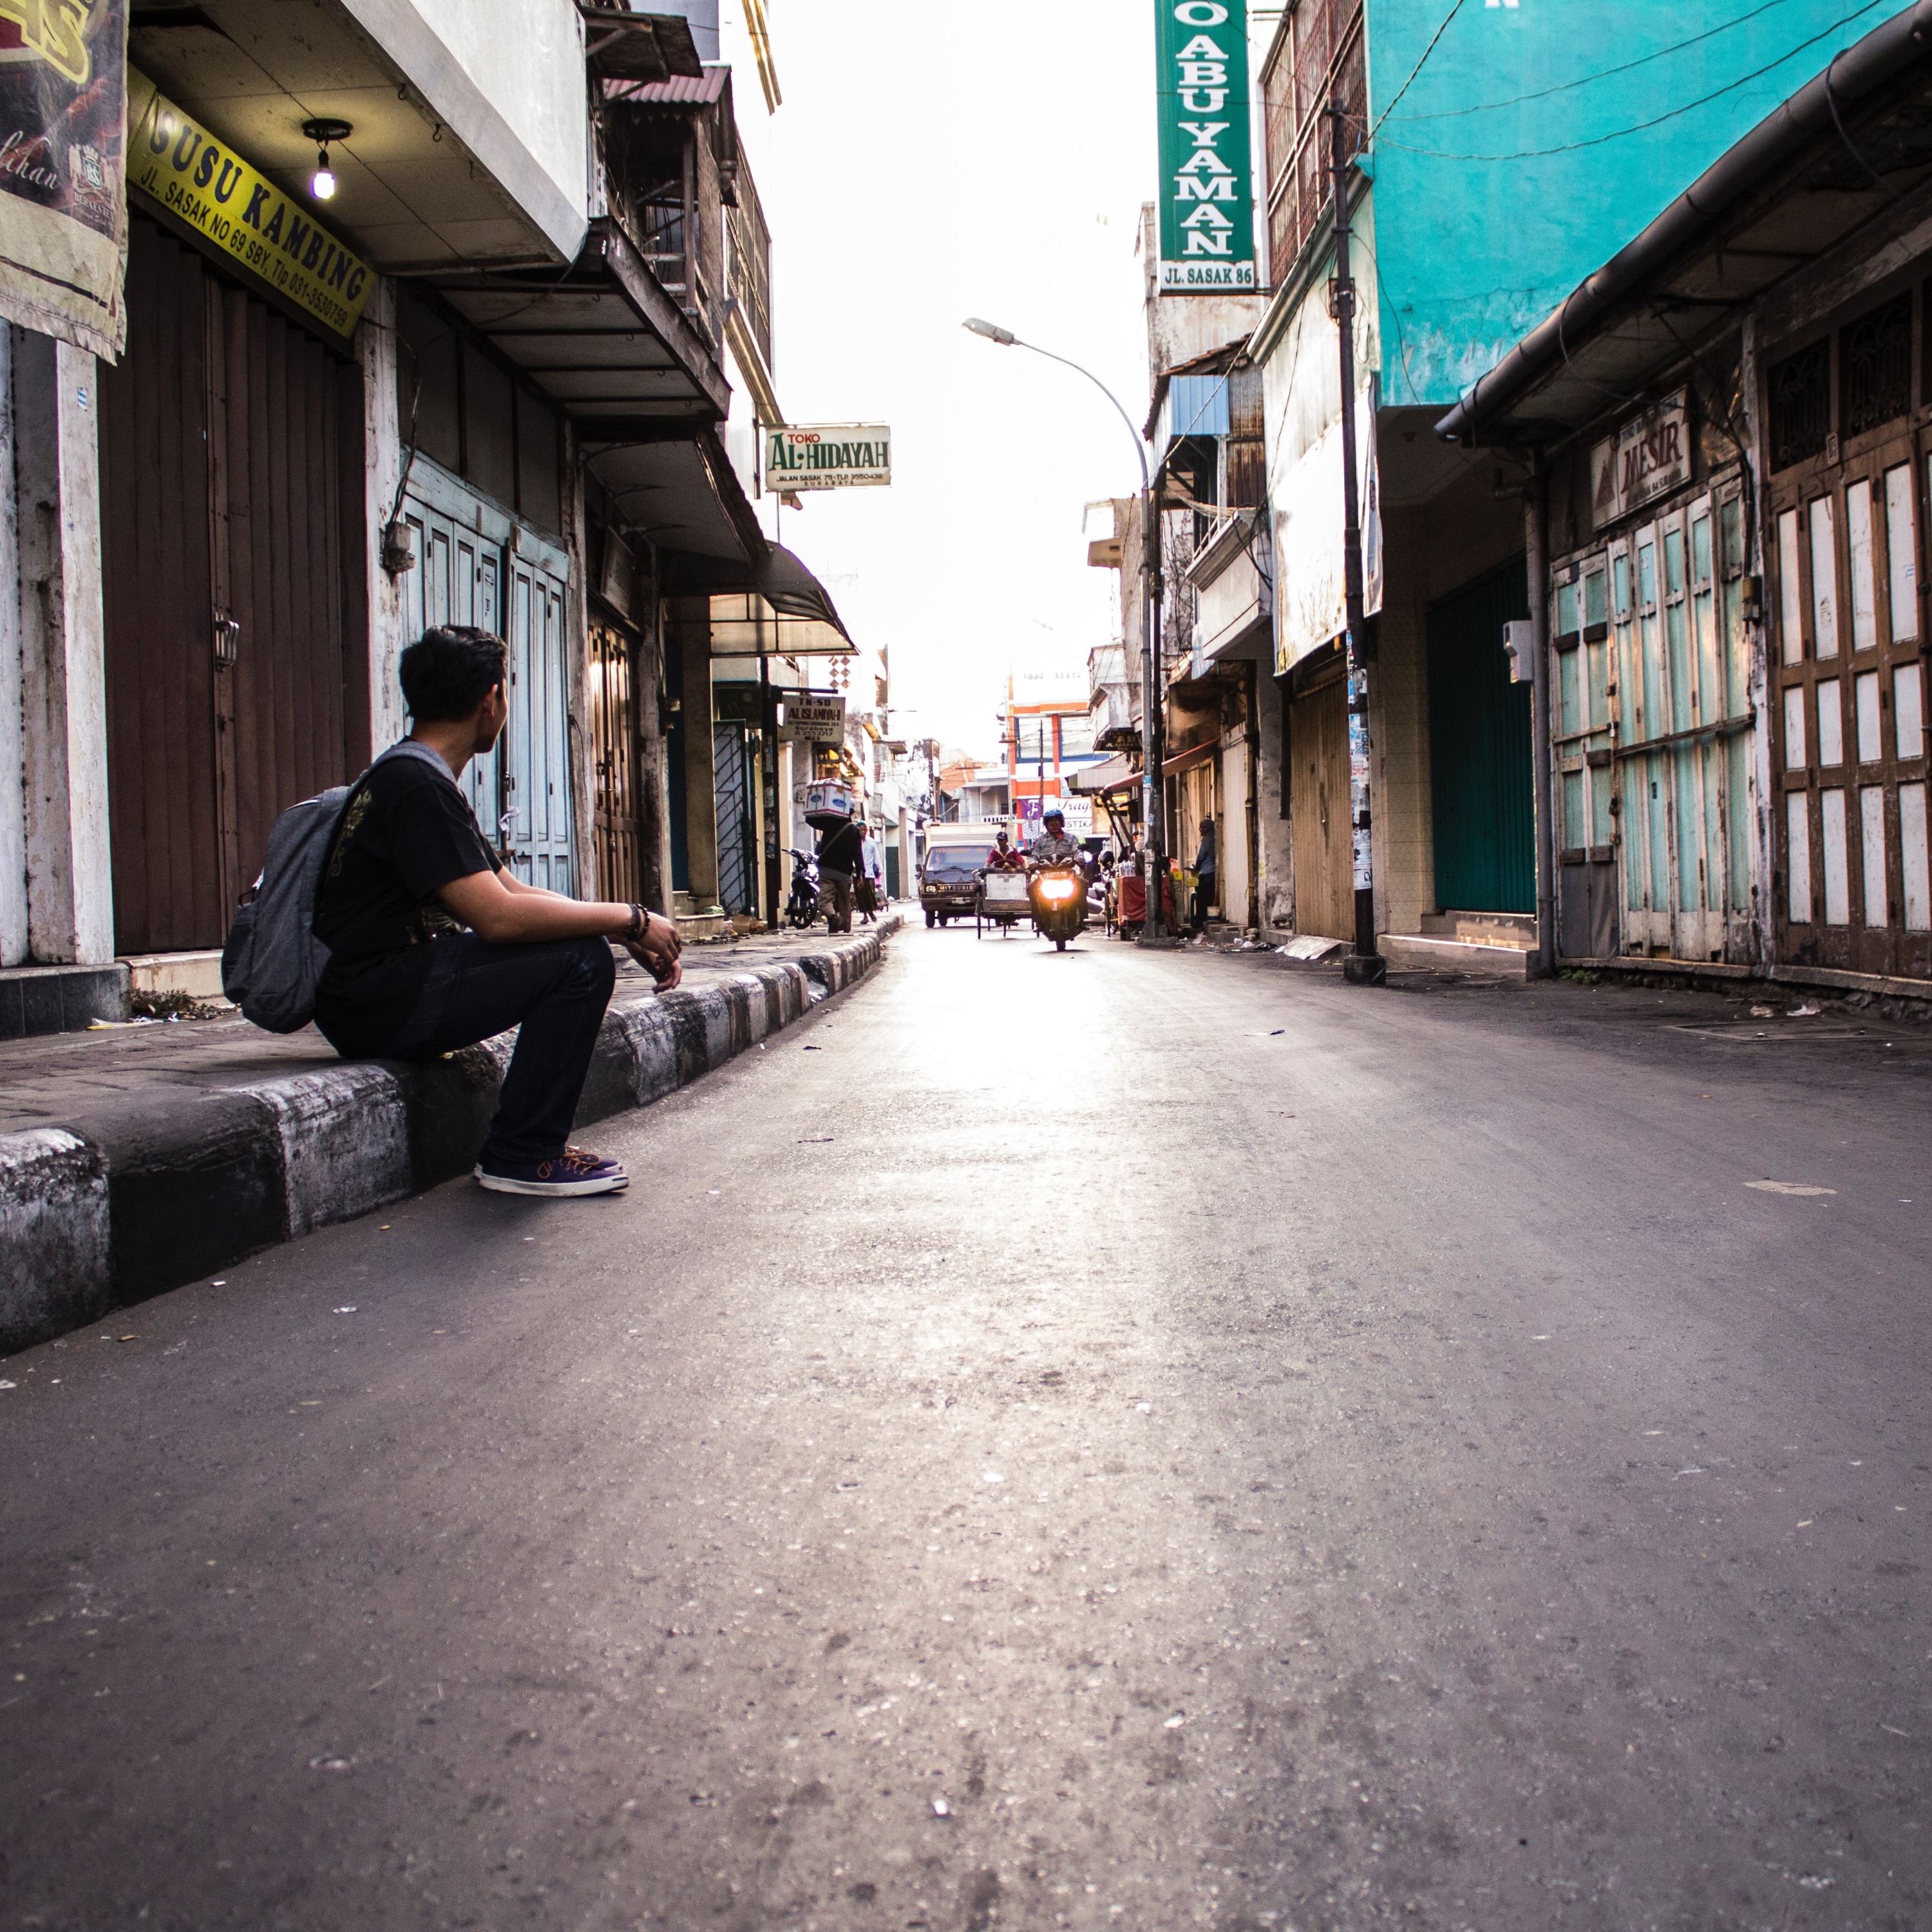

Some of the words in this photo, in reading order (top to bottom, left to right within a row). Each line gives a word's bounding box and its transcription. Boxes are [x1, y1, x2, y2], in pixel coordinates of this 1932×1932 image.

[1175, 35, 1230, 112] ABU
[141, 165, 160, 194] JL.
[165, 181, 211, 225] SASAK
[210, 213, 230, 240] NO
[230, 229, 246, 252] 69
[149, 110, 242, 204] SUSU
[242, 183, 366, 301] KAMBING
[1173, 122, 1238, 255] YAMAN
[1165, 268, 1184, 283] JL.
[1188, 268, 1233, 283] SASAK
[1236, 268, 1252, 283] 86
[788, 433, 820, 444] TOKO
[1620, 421, 1683, 495] MESIR
